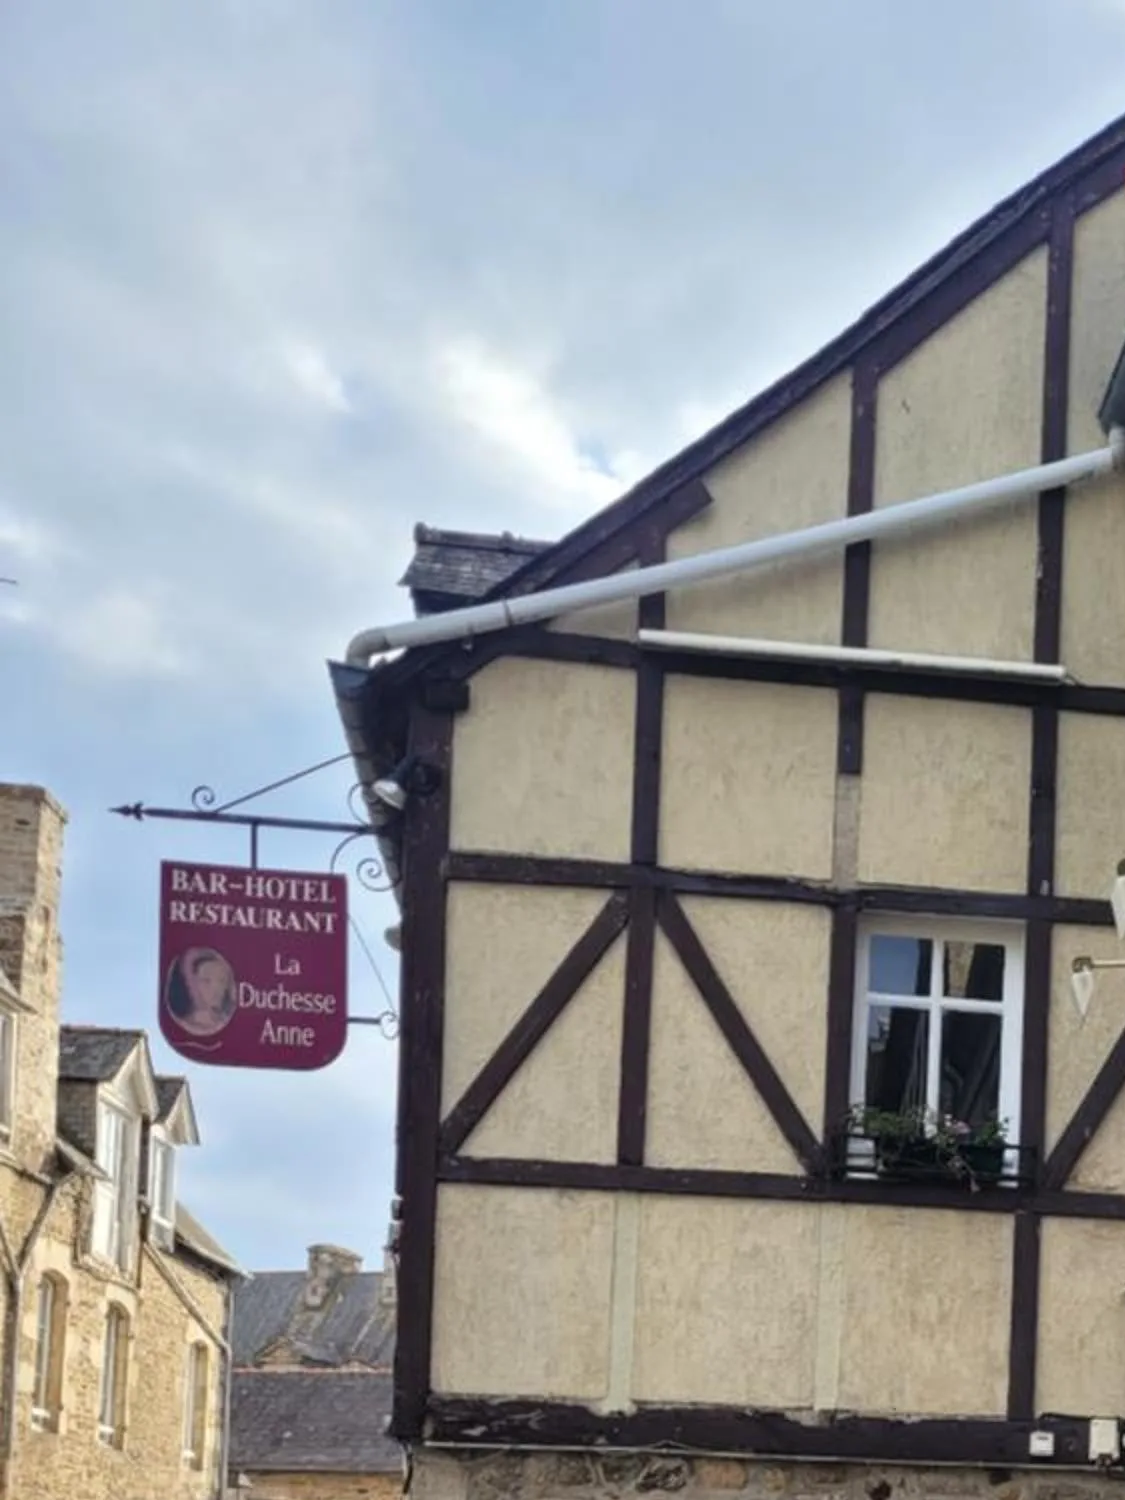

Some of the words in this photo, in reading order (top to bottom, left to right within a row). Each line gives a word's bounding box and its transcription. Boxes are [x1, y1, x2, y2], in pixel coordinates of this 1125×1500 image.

[170, 868, 338, 904] BAR-HOTEL
[169, 900, 339, 934] RESTAURANT
[274, 953, 302, 976] La
[238, 981, 337, 1014] Duchesse
[259, 1018, 316, 1047] Anne
